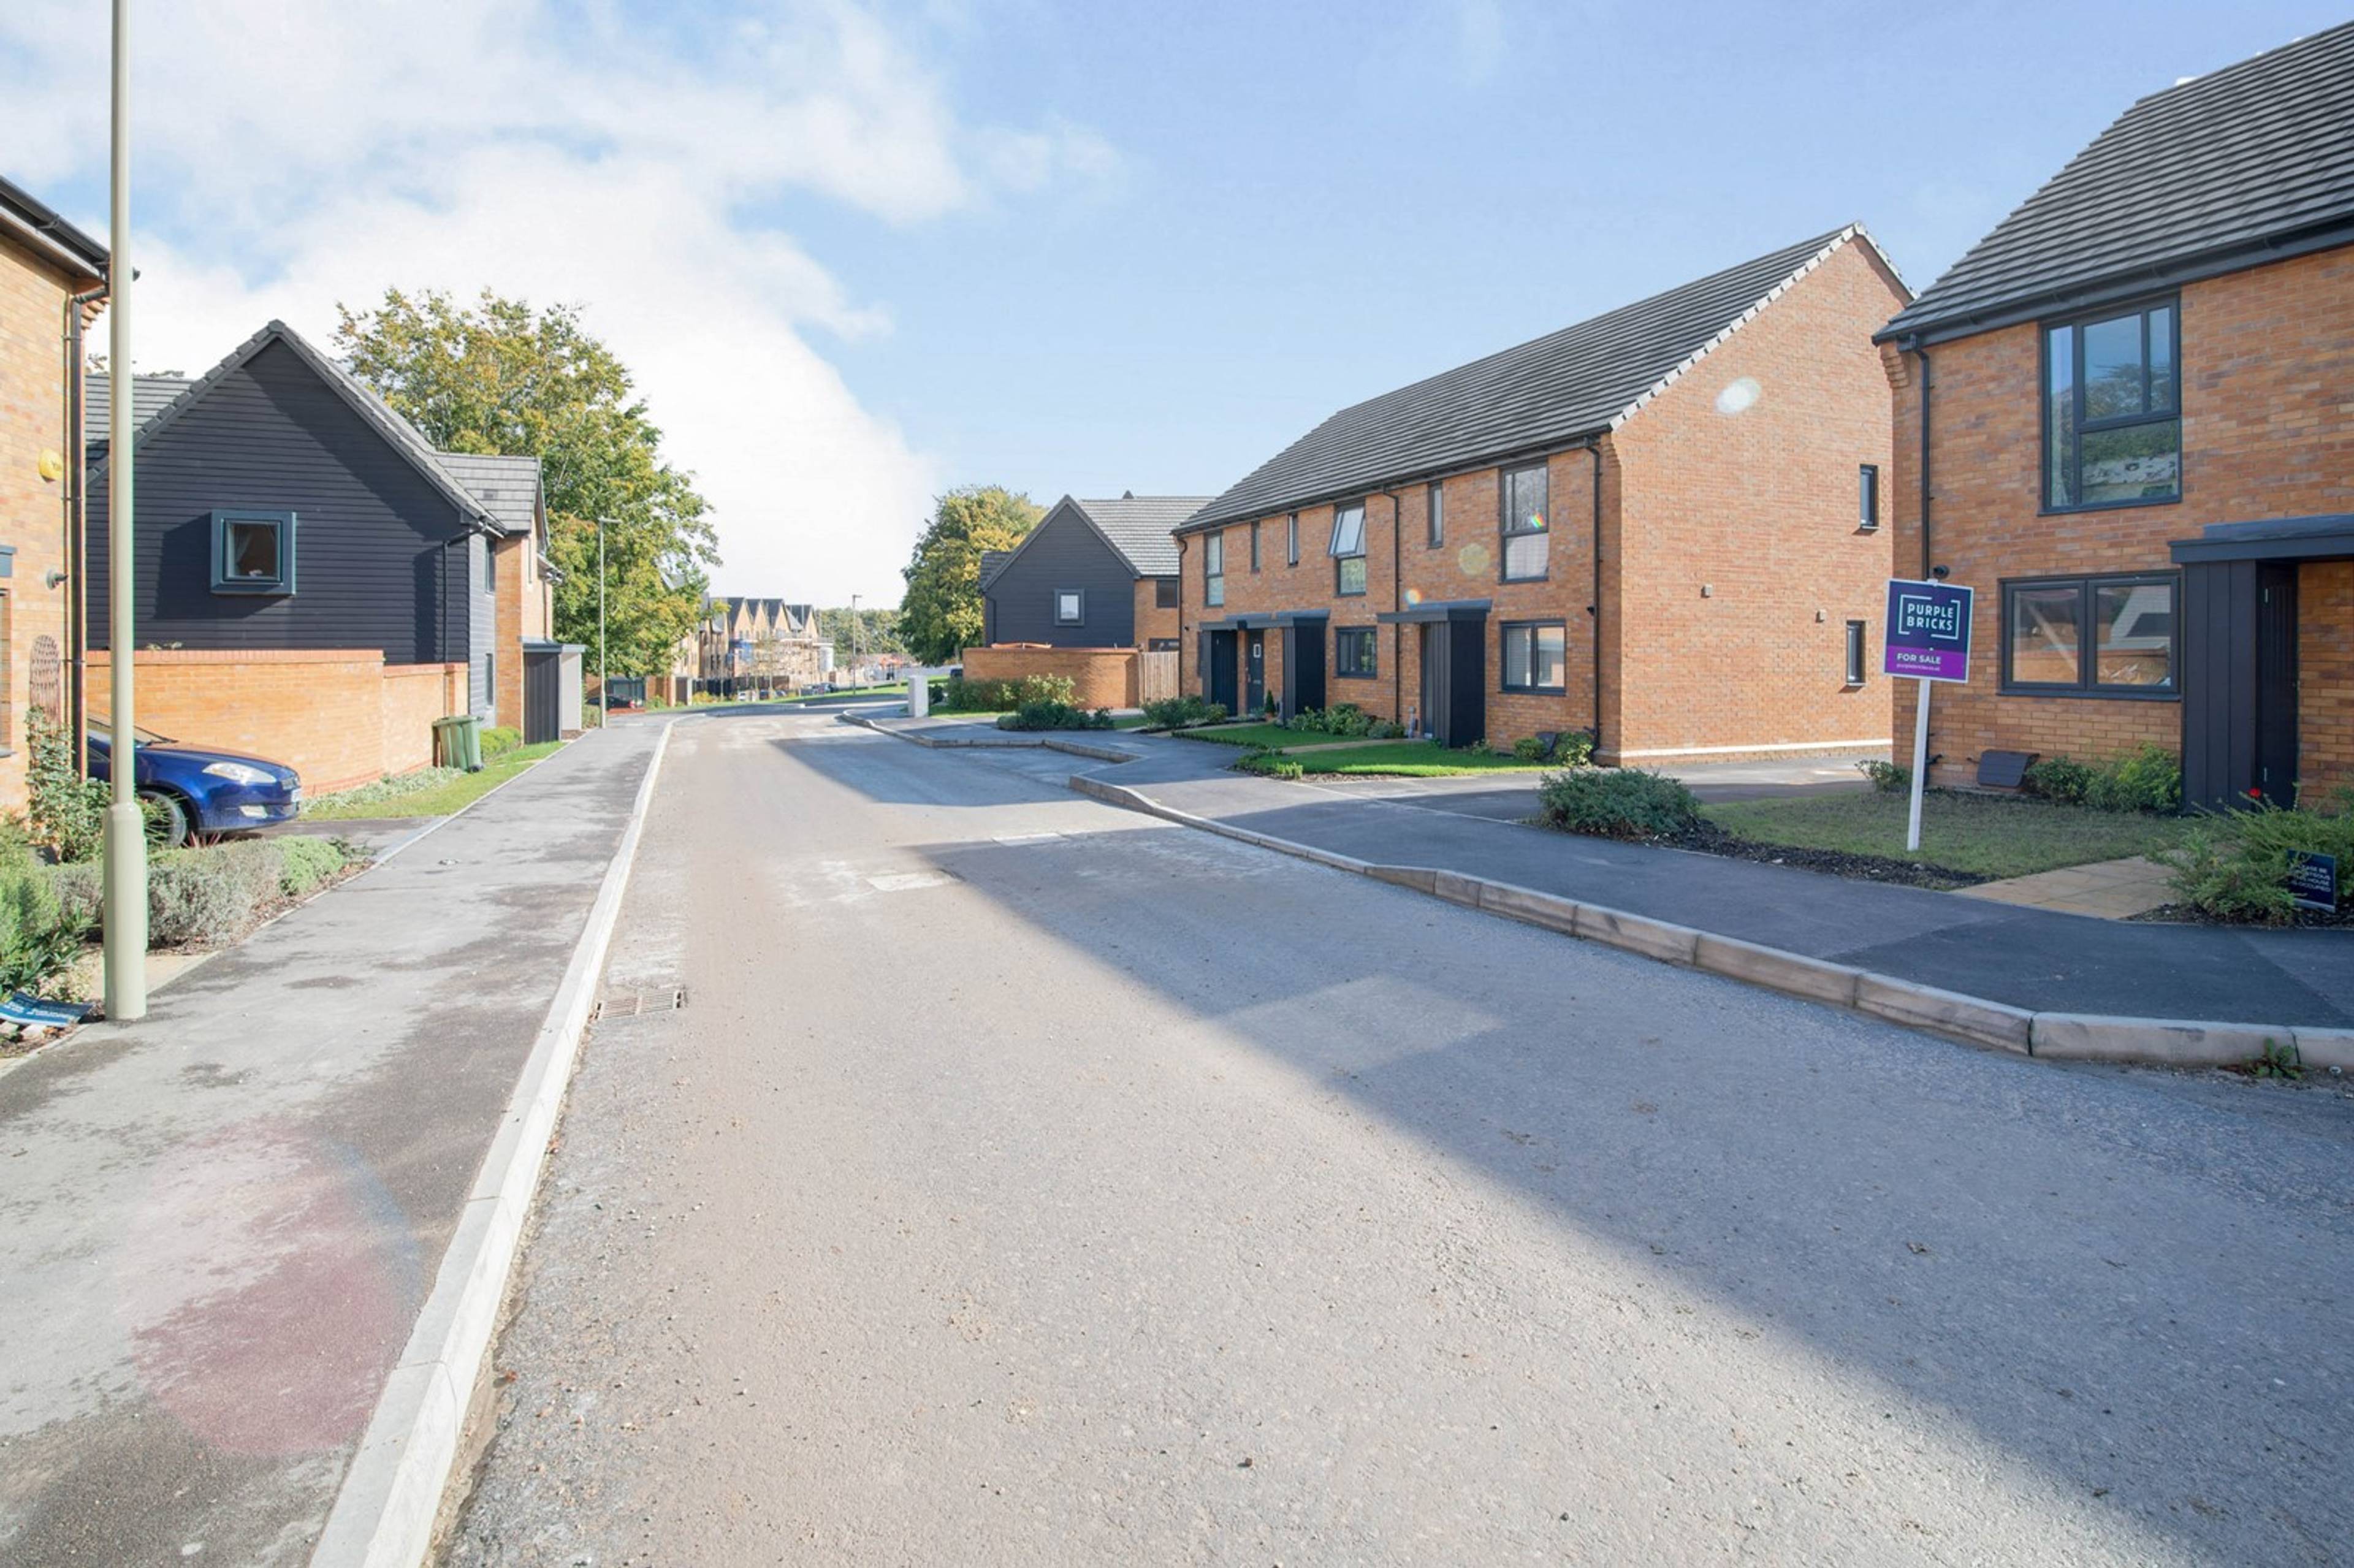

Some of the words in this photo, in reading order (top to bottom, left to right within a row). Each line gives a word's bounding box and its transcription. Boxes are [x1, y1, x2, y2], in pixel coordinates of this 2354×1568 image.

[1907, 603, 1954, 618] PURPLE
[1906, 616, 1953, 631] BRICKS
[1897, 653, 1917, 662] FOR
[1919, 655, 1941, 664] SALE
